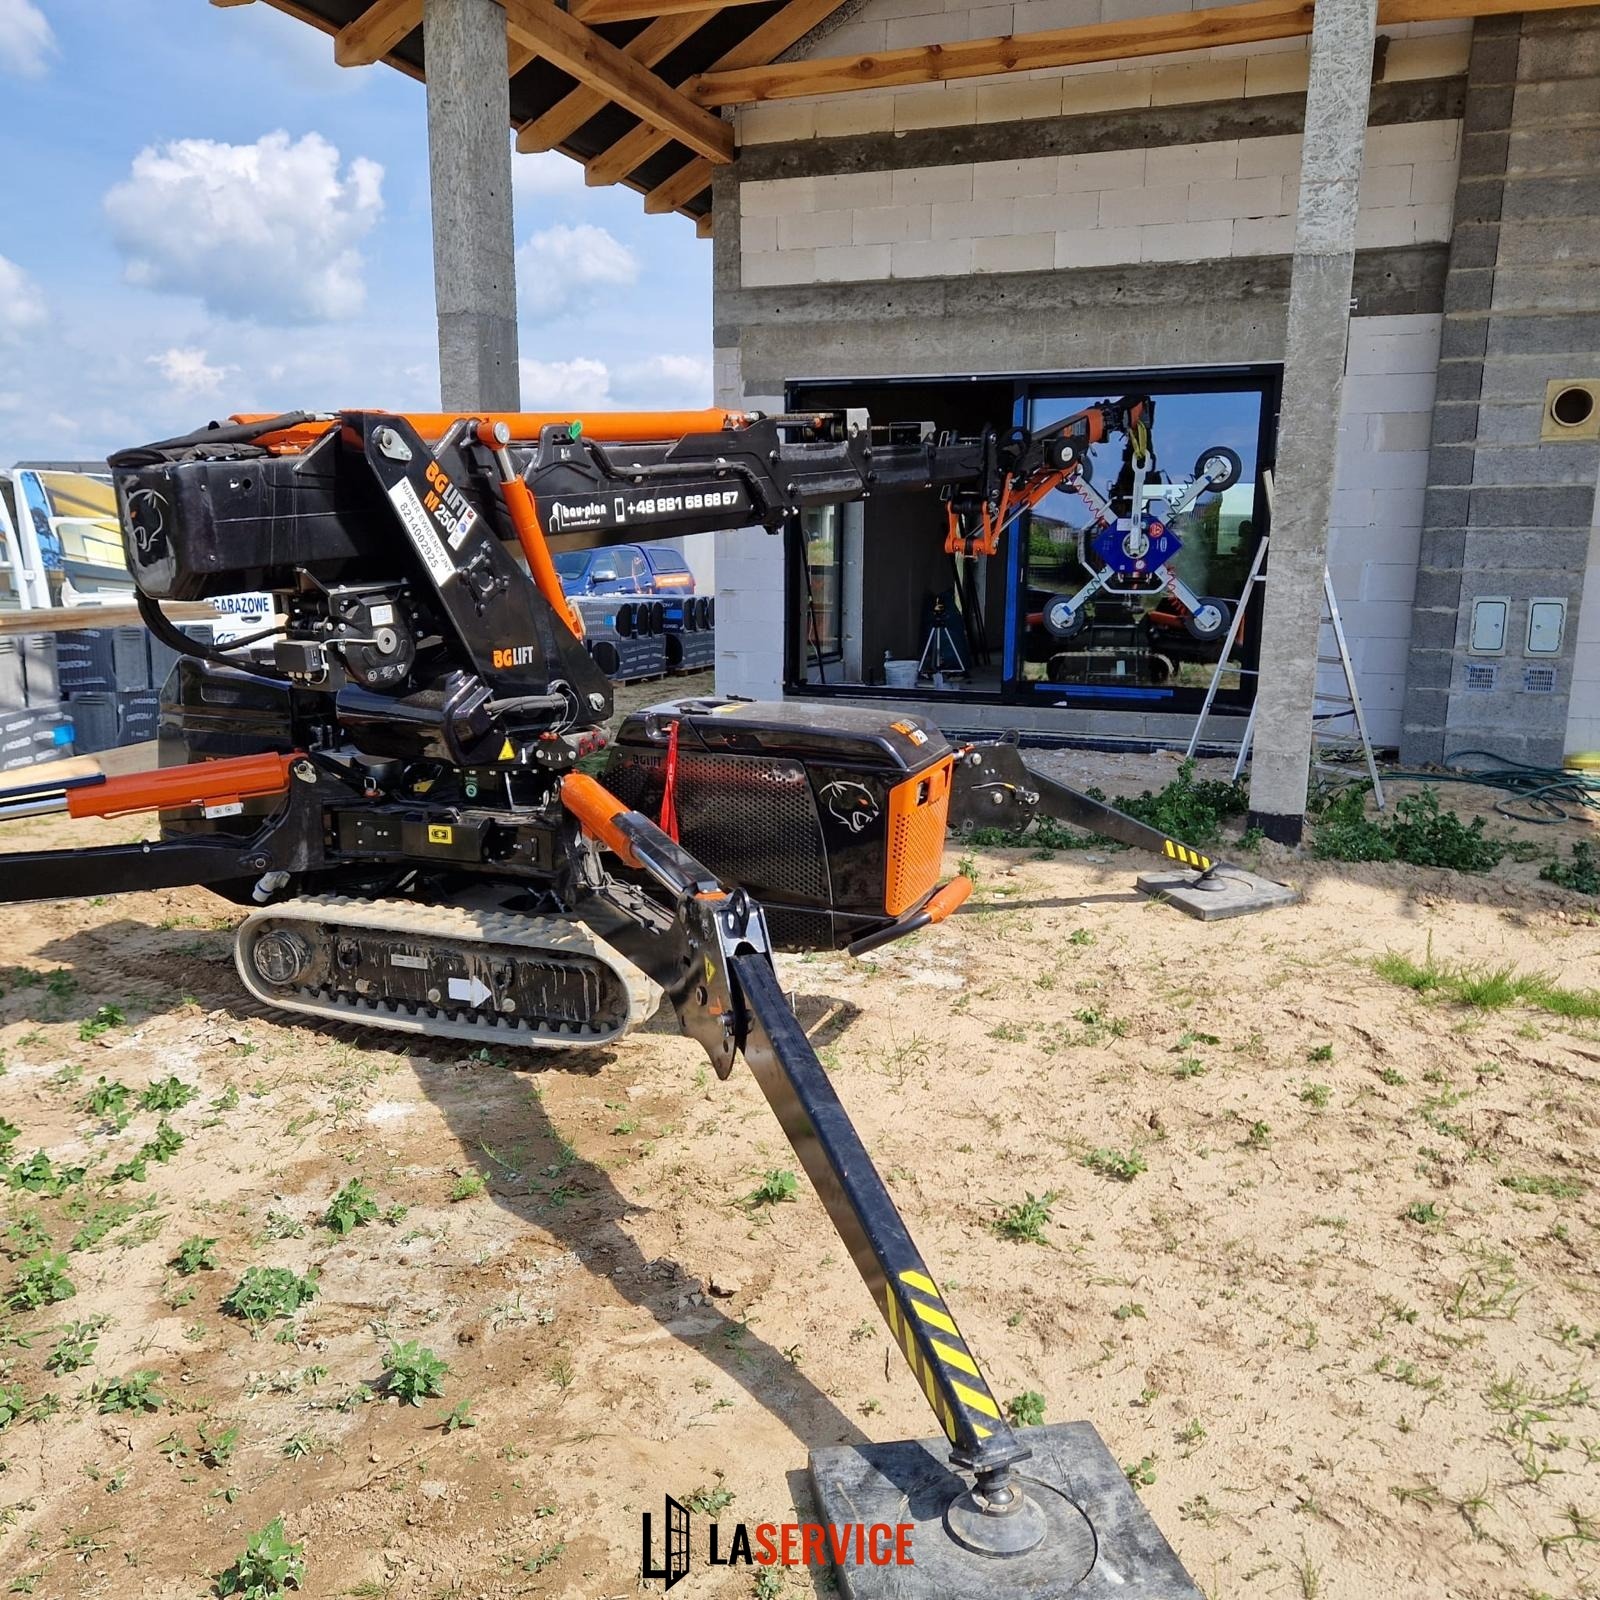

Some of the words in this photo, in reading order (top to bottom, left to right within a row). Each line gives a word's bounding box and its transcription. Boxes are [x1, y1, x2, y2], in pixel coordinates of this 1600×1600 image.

[627, 499, 655, 514] +48
[657, 496, 682, 512] 881
[685, 495, 703, 509] 68
[704, 493, 721, 507] 68
[400, 502, 439, 568] 8214002925
[402, 481, 421, 514] NUMER
[418, 513, 453, 573] EWIDENCYJNY
[493, 646, 533, 668] BGLIFT
